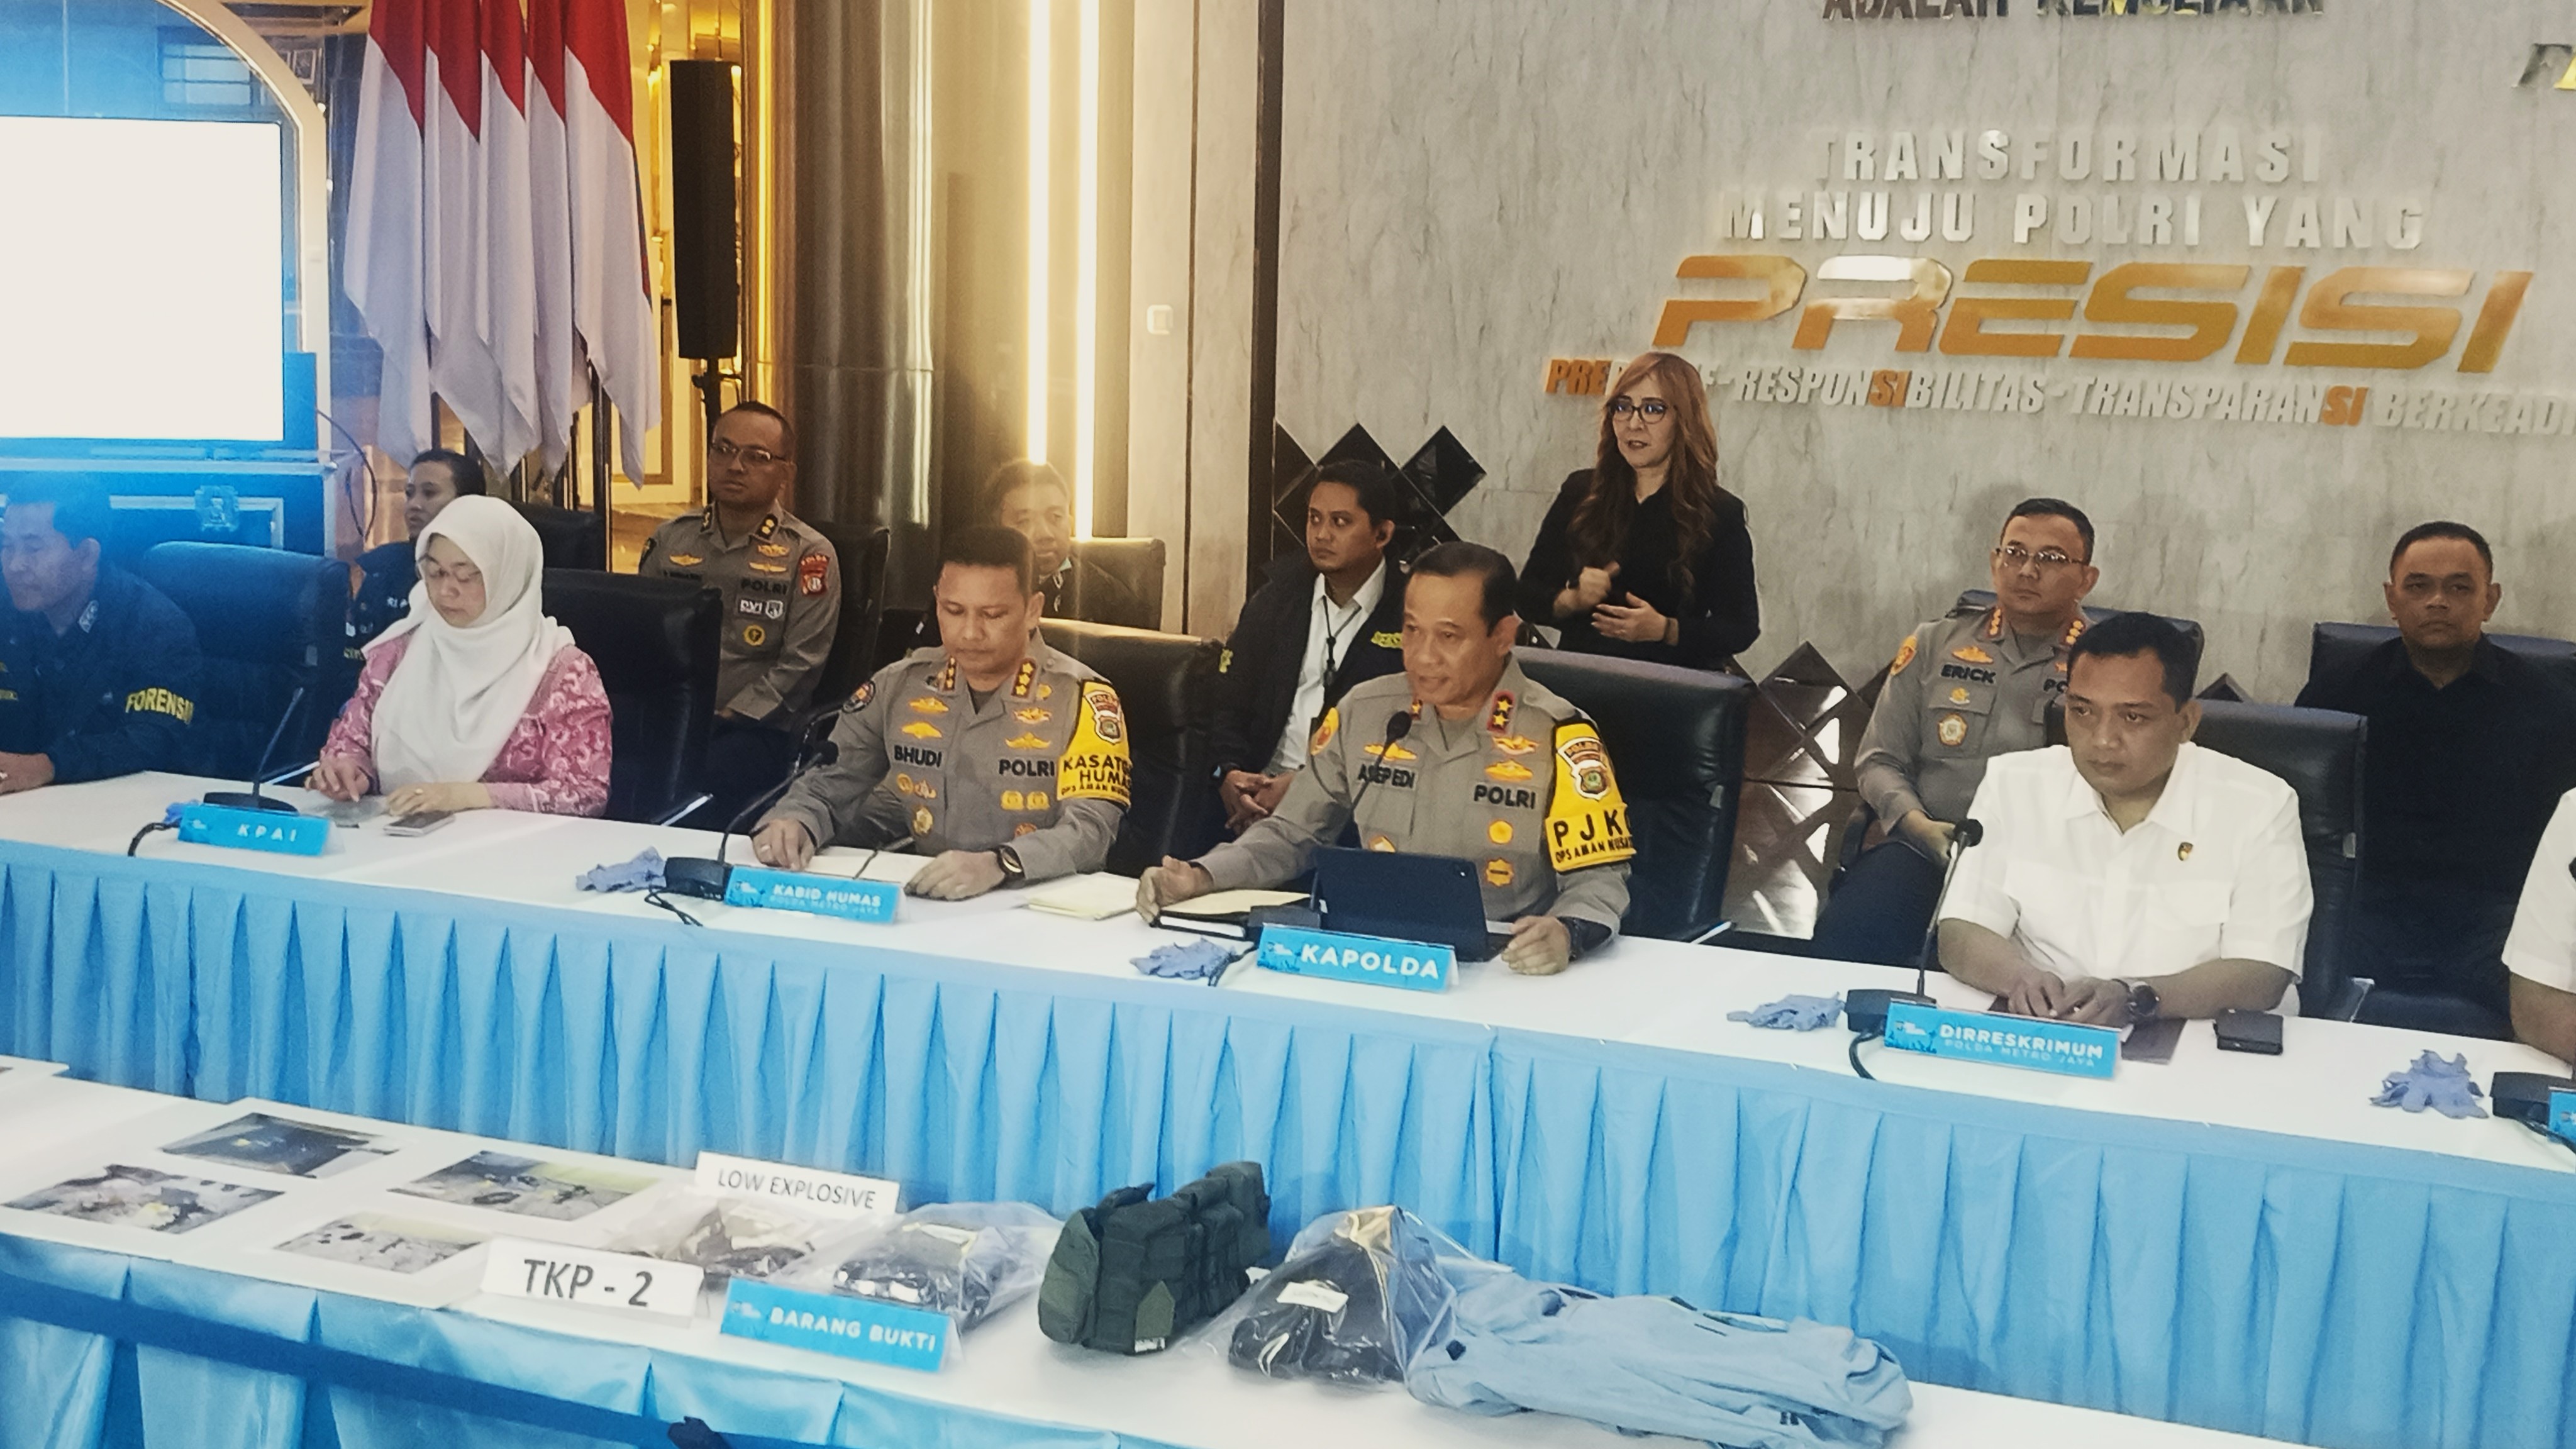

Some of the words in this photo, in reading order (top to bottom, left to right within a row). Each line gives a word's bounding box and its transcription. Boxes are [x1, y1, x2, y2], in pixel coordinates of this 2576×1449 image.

[1805, 129, 2322, 182] TRANSFORMASI
[1722, 191, 1975, 243] MENUJU
[2013, 192, 2201, 247] POLRI
[2241, 195, 2424, 250] YANG
[1652, 254, 2534, 374] PRESISI
[740, 579, 786, 596] POLRI
[1941, 663, 1997, 684] ERICK
[894, 745, 942, 768] BHUDI
[999, 758, 1055, 777] POLRI
[1473, 784, 1536, 809] POLRI
[236, 823, 297, 843] KPAI
[1574, 841, 1606, 858] AMAN
[773, 882, 822, 901] KABID
[826, 890, 882, 908] HUMAS
[1300, 943, 1439, 980] KAPOLDA
[1939, 1023, 2104, 1060] DIRRESKRIMUM
[1943, 1038, 1994, 1054] POLDA
[2001, 1046, 2050, 1062] METRO
[2058, 1052, 2095, 1067] JAYA
[718, 1167, 765, 1192] LOW
[770, 1177, 877, 1209] EXPLOSIVE
[524, 1258, 594, 1299] TKP
[628, 1270, 653, 1307] 2
[770, 1306, 862, 1338] BARANG
[870, 1324, 936, 1352] BUKTI
